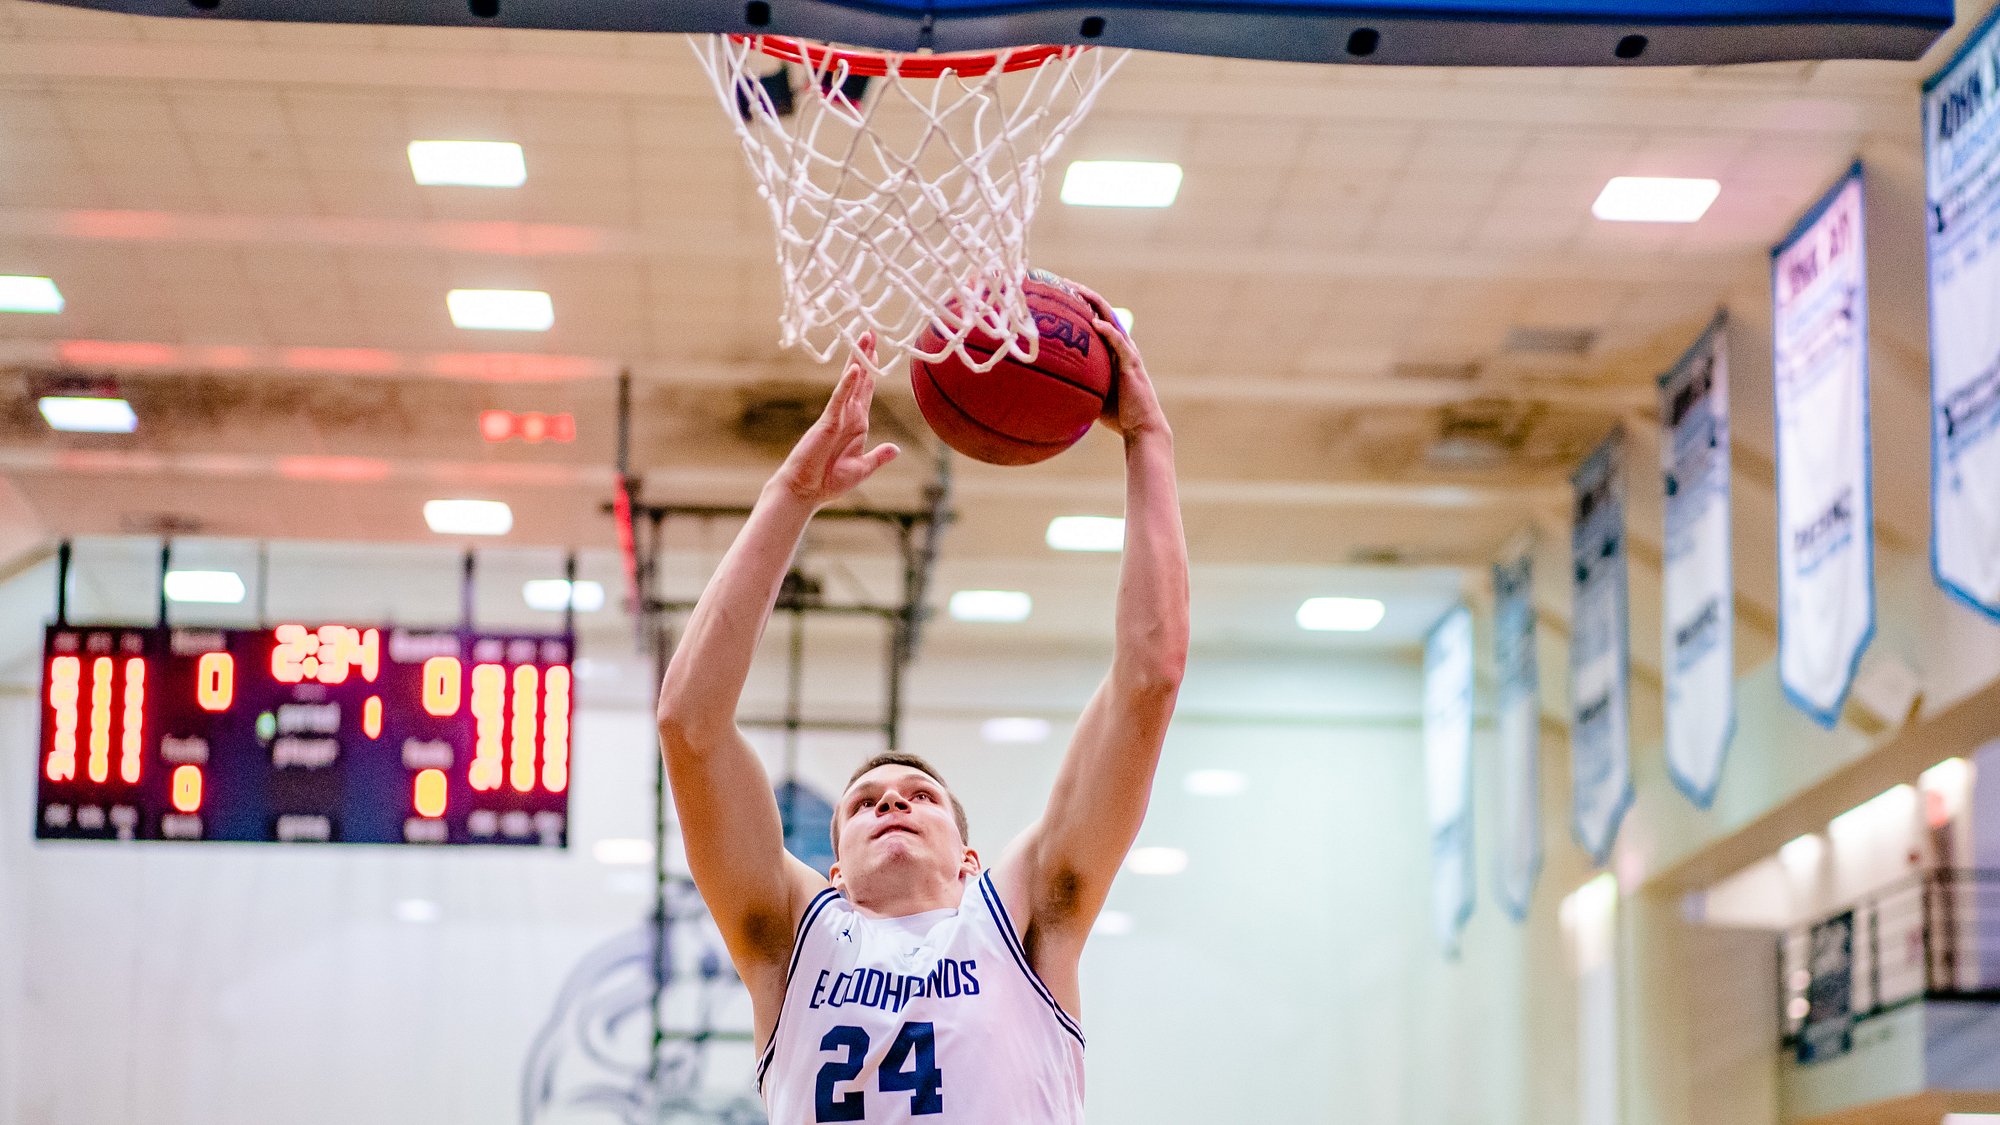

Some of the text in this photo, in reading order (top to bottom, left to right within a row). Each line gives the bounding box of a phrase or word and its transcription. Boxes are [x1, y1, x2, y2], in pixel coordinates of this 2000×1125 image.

[1029, 308, 1090, 357] CAA
[197, 651, 236, 713] 0
[272, 624, 380, 684] 2:34
[423, 656, 462, 717] 0
[815, 1021, 943, 1124] 24
